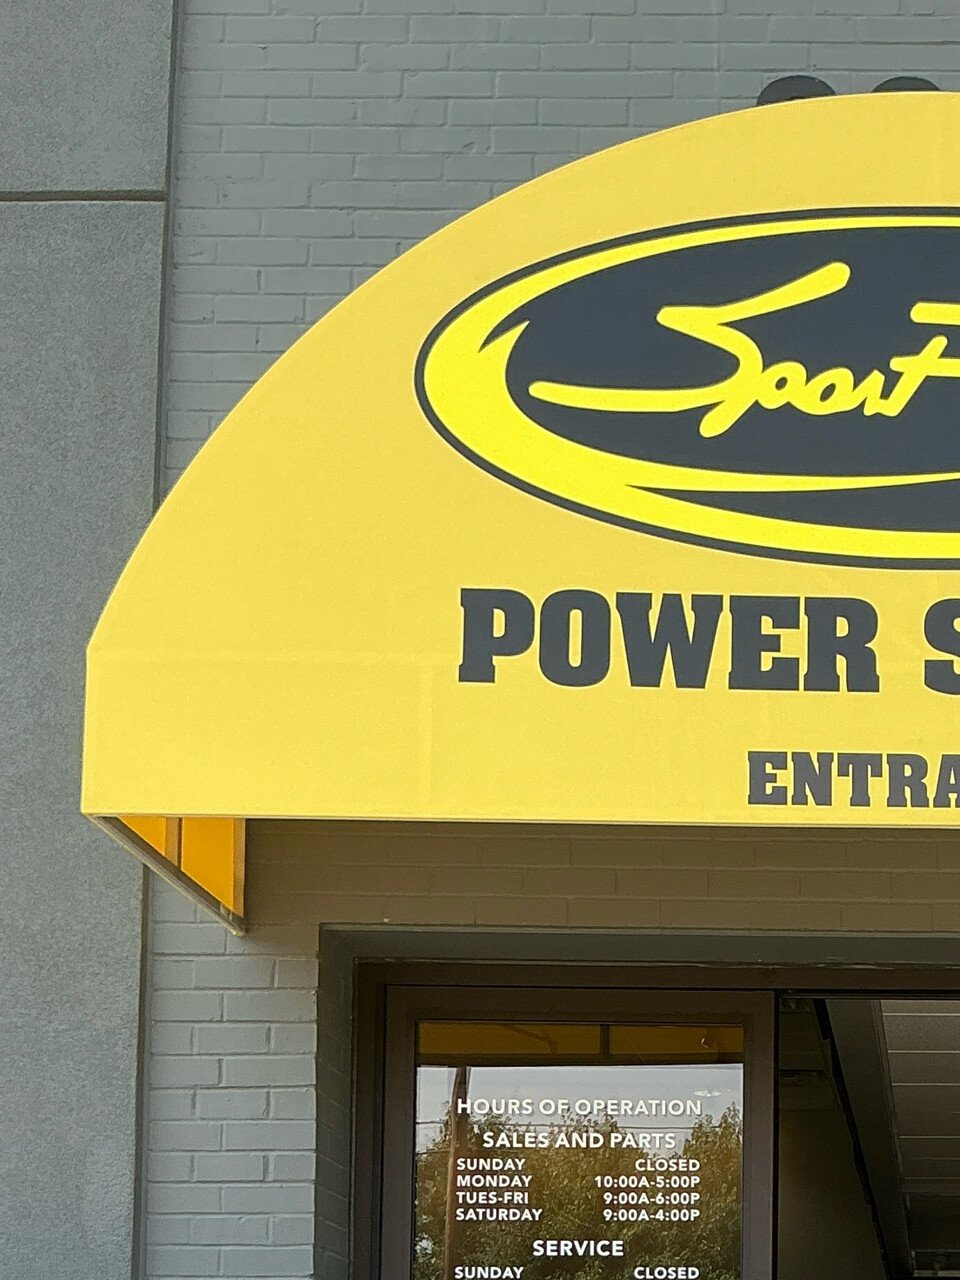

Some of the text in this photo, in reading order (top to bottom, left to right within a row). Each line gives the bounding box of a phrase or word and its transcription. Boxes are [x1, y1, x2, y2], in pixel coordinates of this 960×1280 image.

[457, 588, 880, 693] POWER
[457, 1098, 701, 1115] HOURS OF OPERATION
[483, 1132, 676, 1148] SALES AND PARTS
[456, 1159, 700, 1171] SUNDAY CLOSED
[456, 1175, 700, 1188] MONDAY 10:00A-5:00P
[456, 1192, 700, 1205] TUES-FRI 9:00A-6:00P
[456, 1209, 700, 1222] SATURDAY 9:00A-4:00P
[532, 1240, 624, 1256] SERVICE
[454, 1267, 699, 1279] SUNDAY CLOSED
